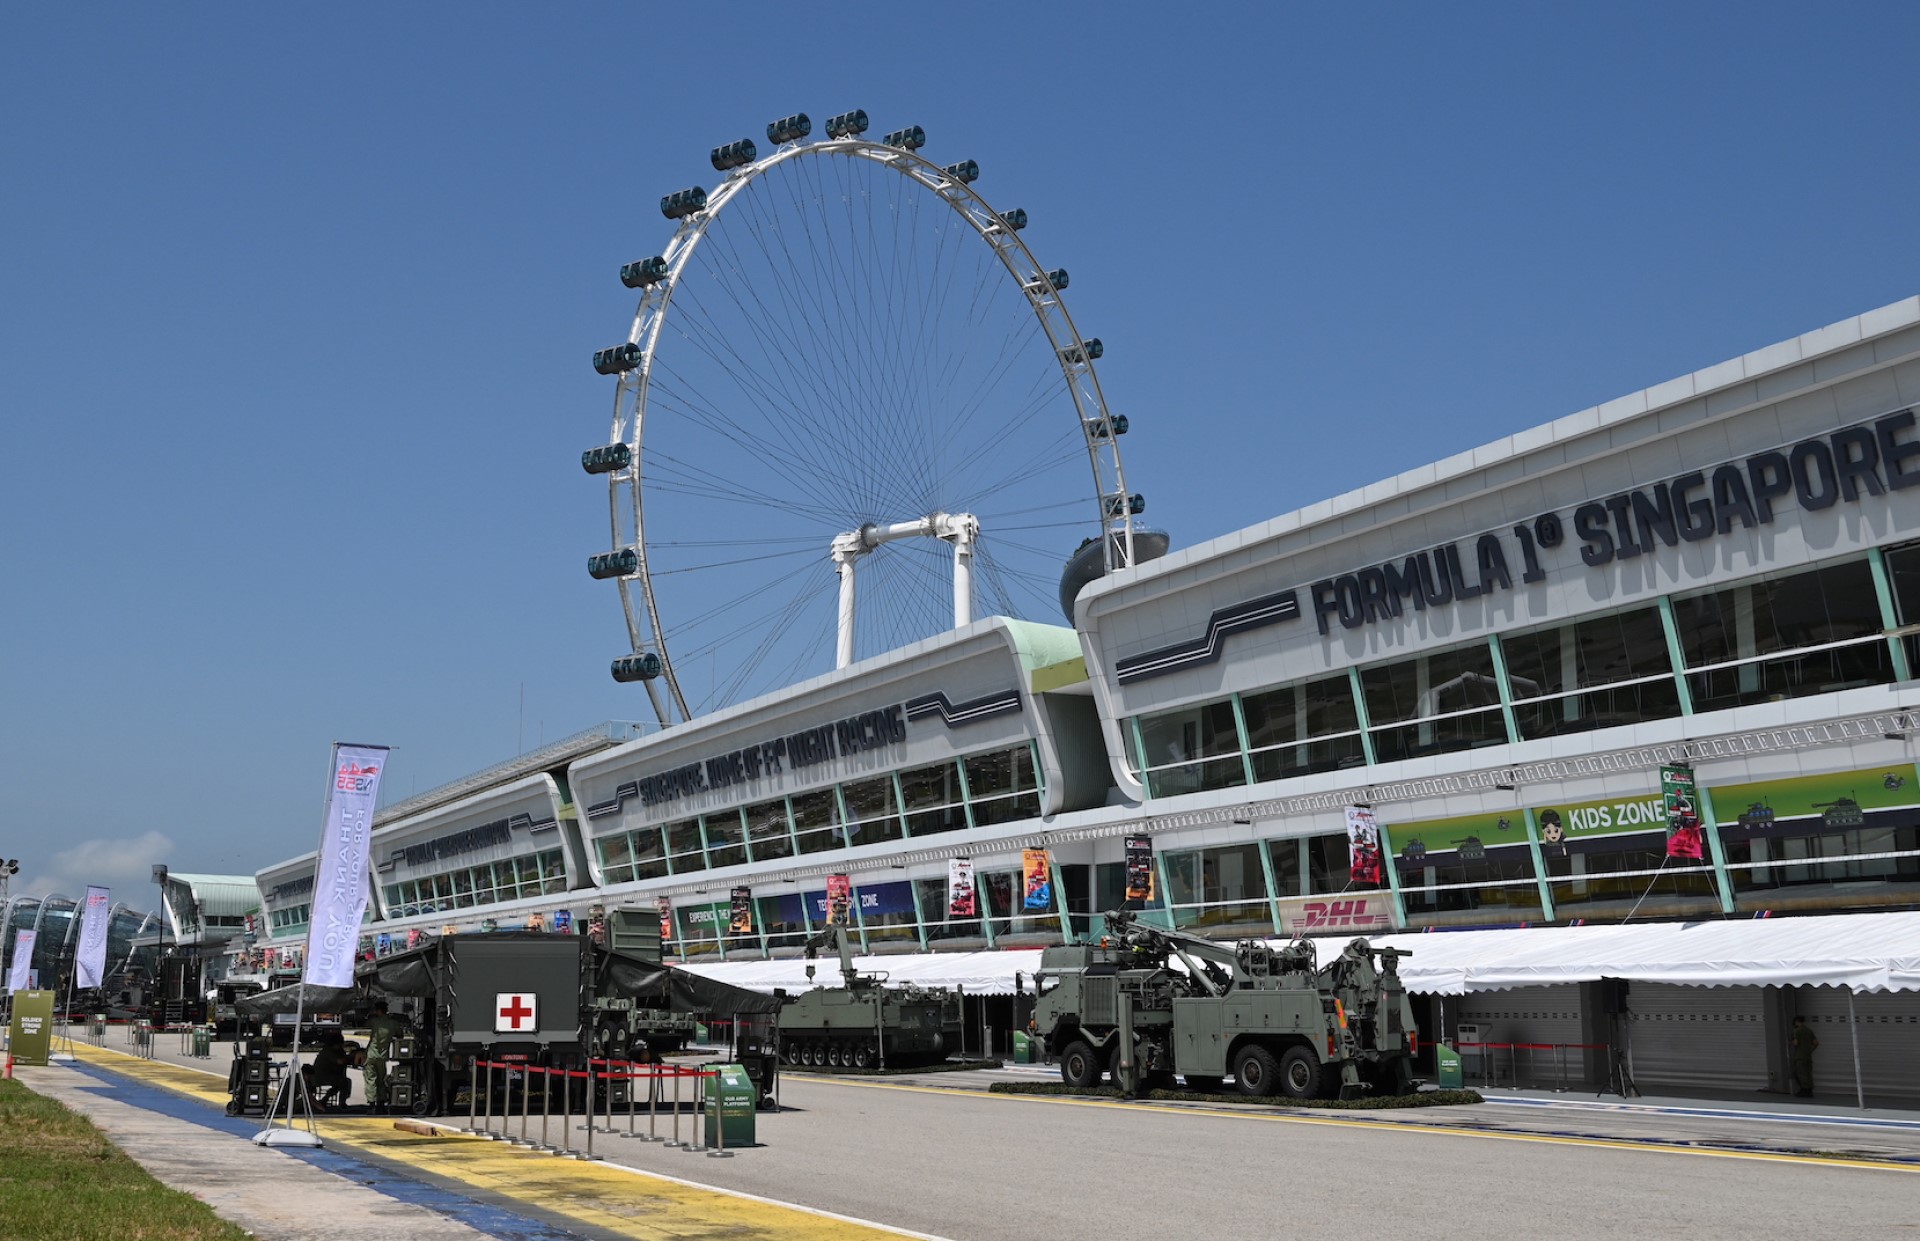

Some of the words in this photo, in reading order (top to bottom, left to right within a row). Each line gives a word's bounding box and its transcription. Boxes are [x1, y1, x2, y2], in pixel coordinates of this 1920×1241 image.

[1311, 534, 1513, 636] FORMULA
[1574, 411, 1920, 567] SINGAPORE
[705, 750, 746, 790] HOME
[743, 745, 763, 781] OF
[786, 723, 837, 770] NIGHT
[835, 703, 907, 758] RACING
[1568, 806, 1612, 830] KIDS
[1613, 799, 1666, 826] ZONE
[860, 893, 879, 908] ZONE
[1303, 900, 1375, 927] DHL
[689, 909, 716, 924] EXPERIENC
